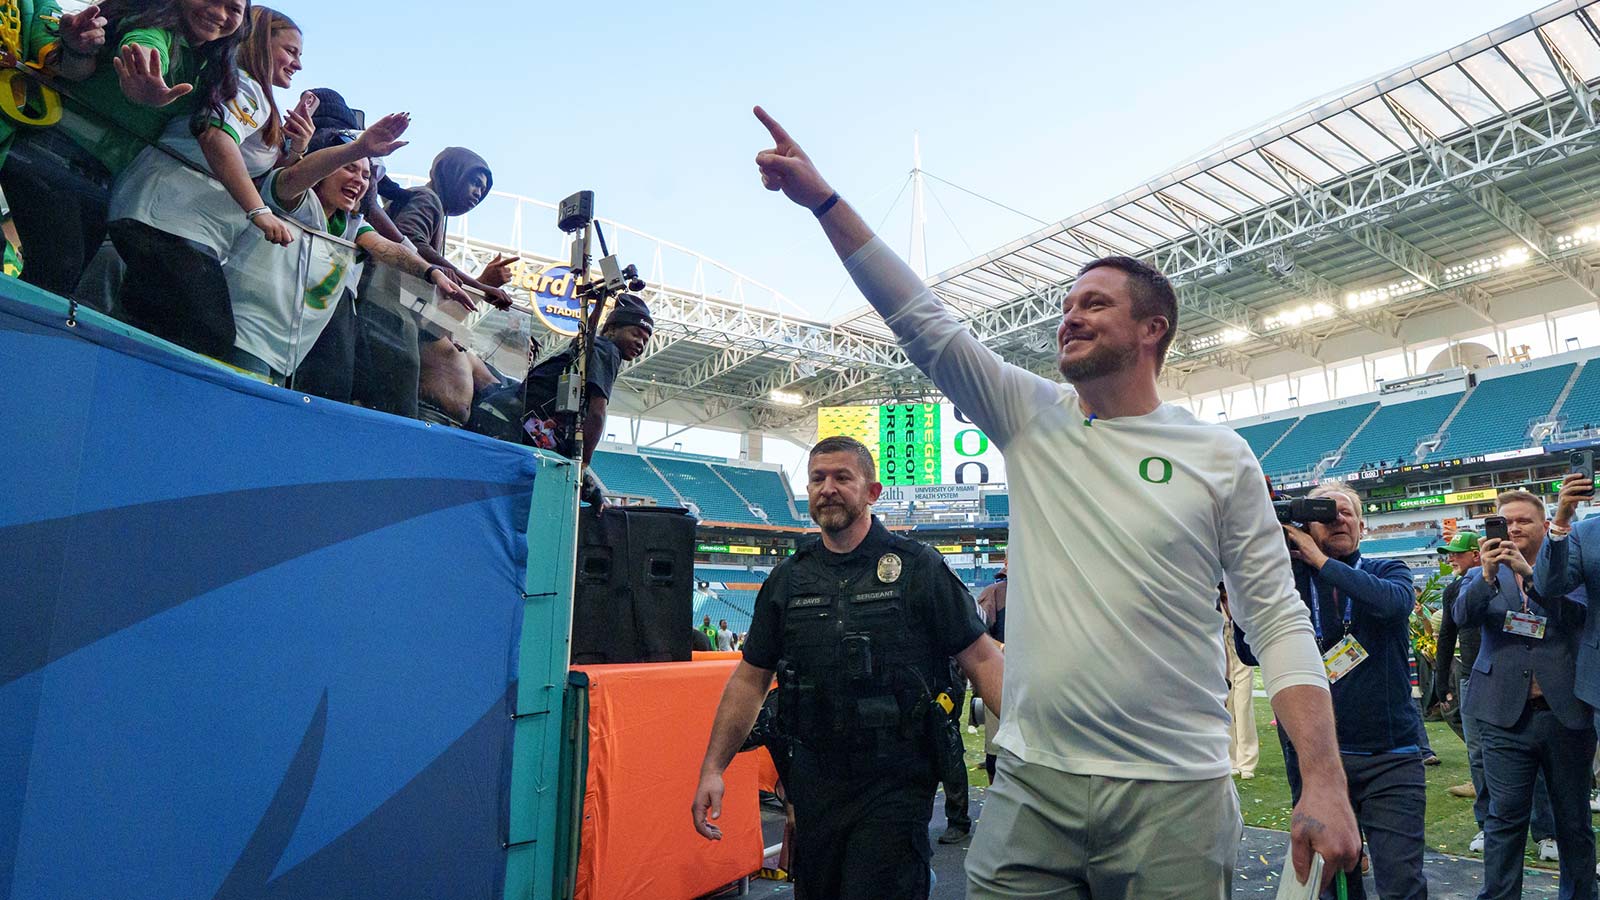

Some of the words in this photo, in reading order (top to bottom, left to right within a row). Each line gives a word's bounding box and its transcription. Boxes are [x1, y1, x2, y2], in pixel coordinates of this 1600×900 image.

[546, 304, 581, 318] STADIU
[1139, 456, 1173, 484] O
[879, 487, 904, 500] alth
[1400, 497, 1442, 507] OREGON
[1456, 491, 1485, 501] CHAMPIONS
[802, 597, 821, 605] DAVIS
[856, 590, 894, 601] SERGEANT
